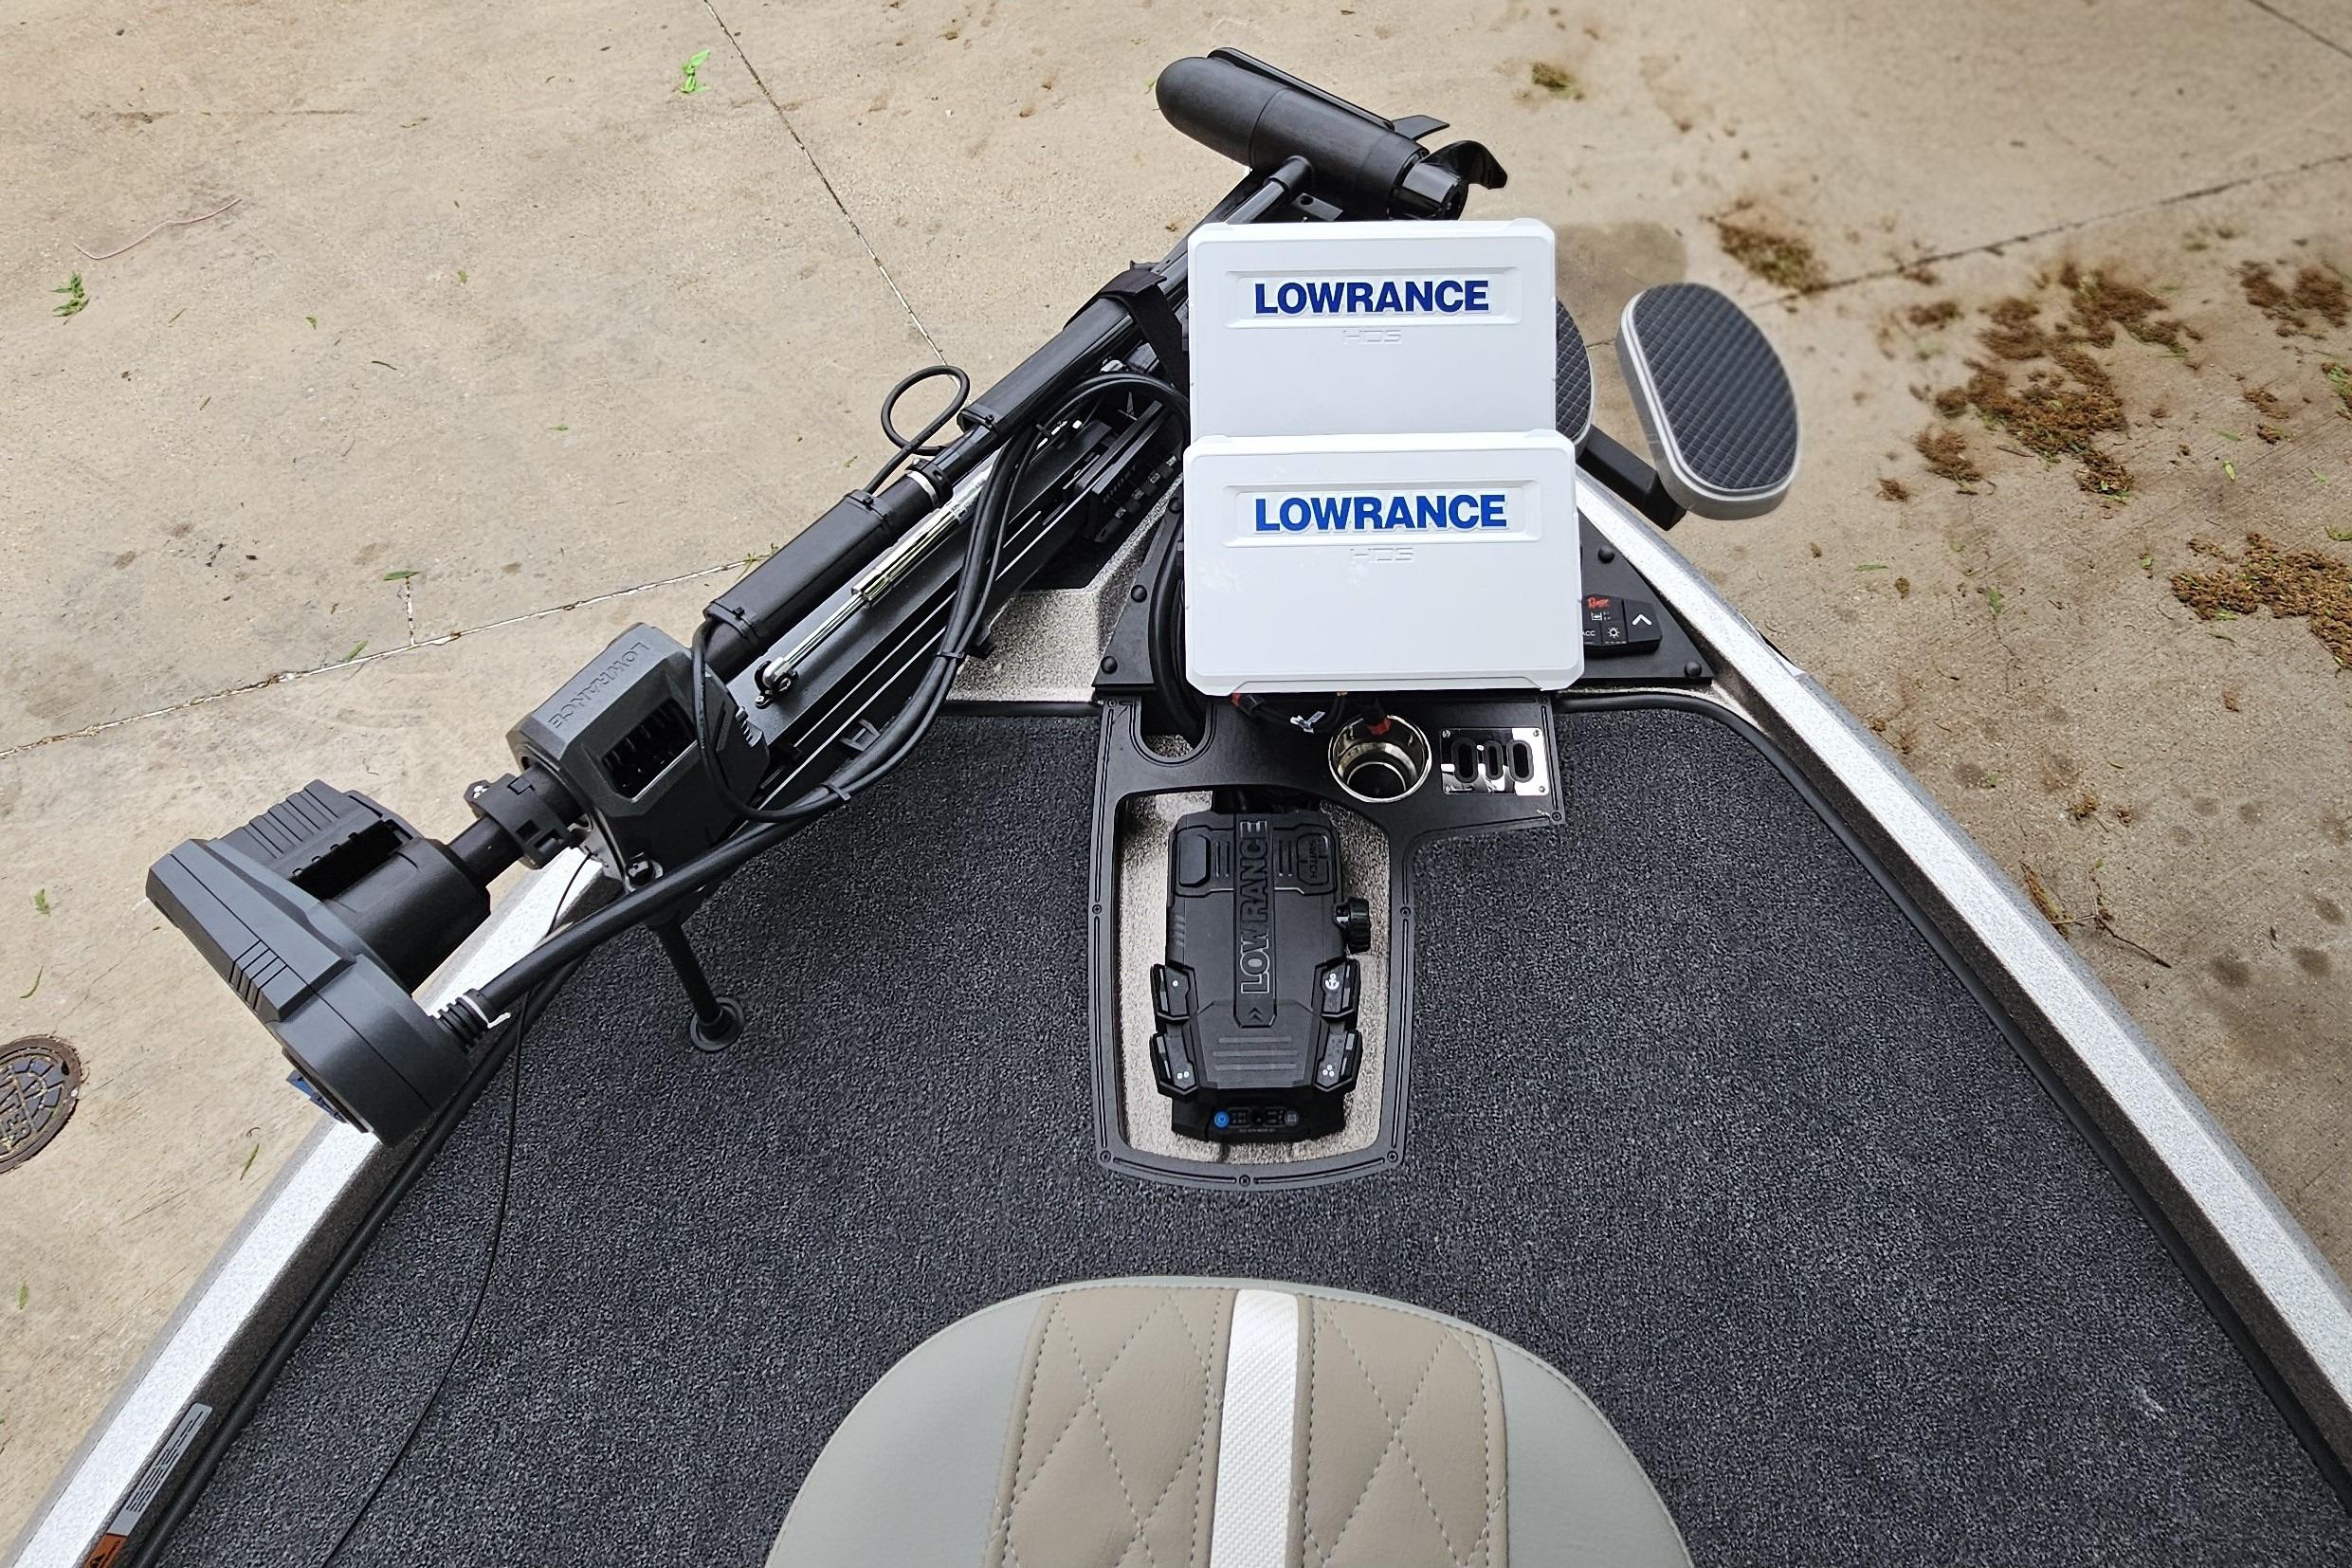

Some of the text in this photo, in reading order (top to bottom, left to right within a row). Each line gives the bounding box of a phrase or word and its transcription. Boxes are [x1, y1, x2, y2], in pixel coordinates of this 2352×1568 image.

[1254, 280, 1490, 315] LOWRANCE
[1342, 329, 1403, 344] HDS
[1254, 493, 1508, 532] LOWRANCE
[1349, 547, 1414, 563] HDS
[548, 641, 650, 729] LOWRANCE
[1239, 820, 1270, 994] LOWRANCE
